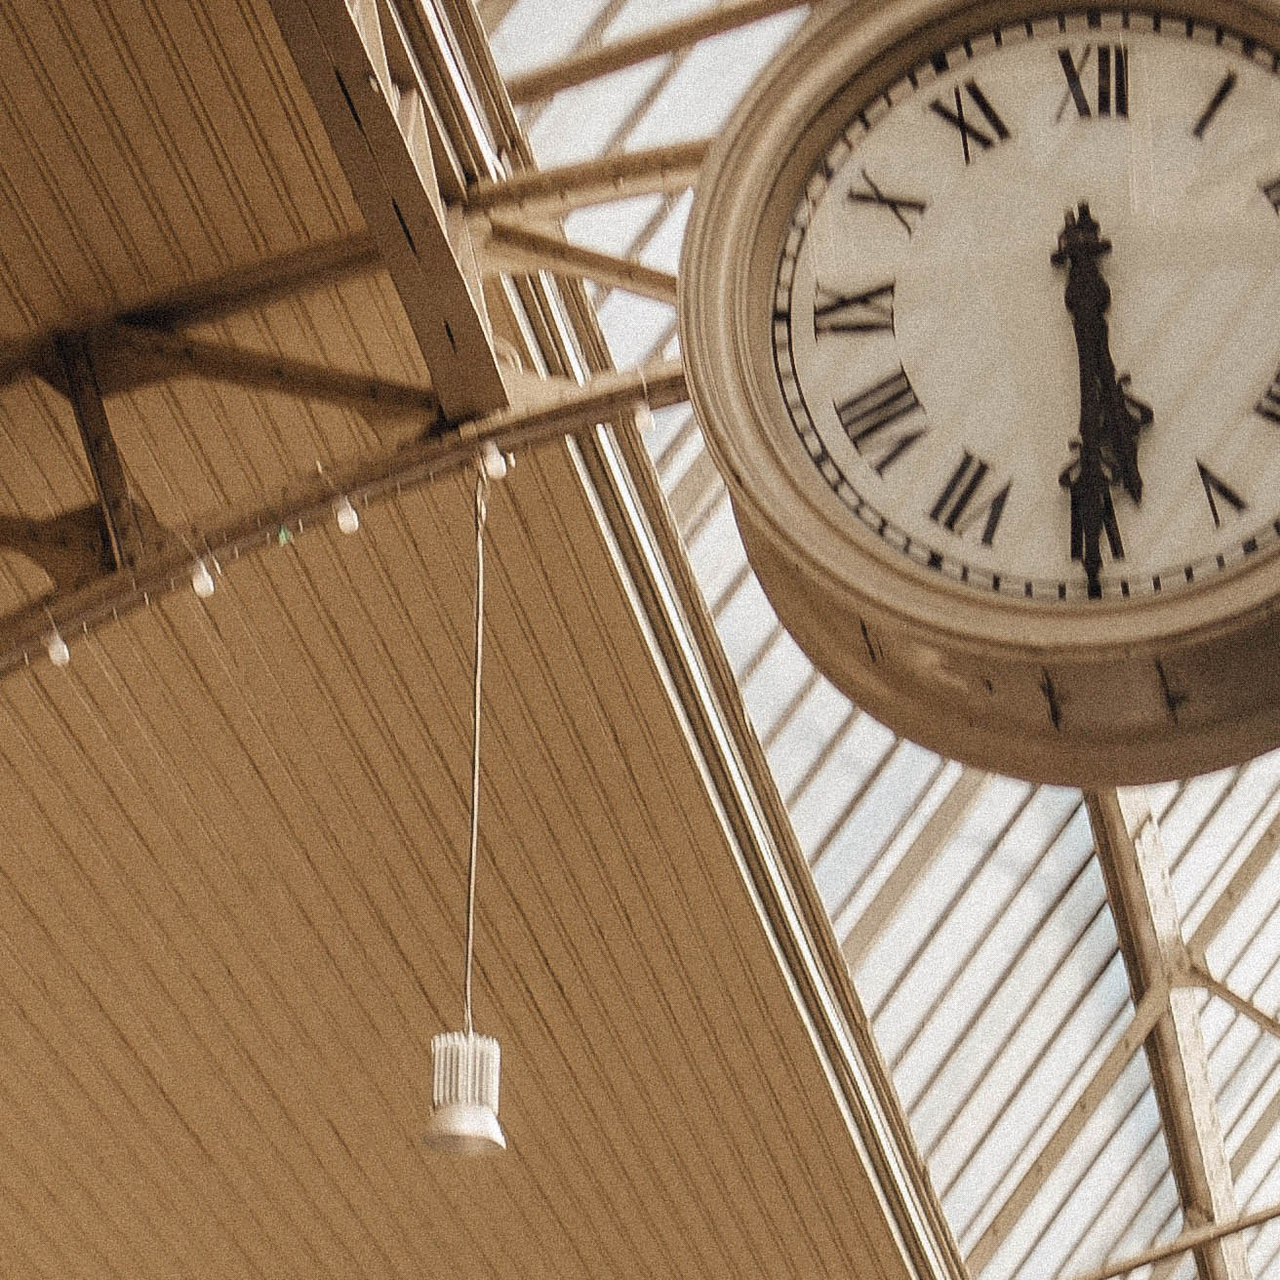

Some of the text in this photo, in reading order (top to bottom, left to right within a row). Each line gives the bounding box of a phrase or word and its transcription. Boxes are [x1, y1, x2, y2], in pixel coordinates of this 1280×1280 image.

[929, 77, 1011, 165] XI
[1055, 42, 1129, 125] XII
[1193, 69, 1238, 139] I
[846, 169, 927, 237] X
[813, 276, 897, 343] IX
[832, 360, 930, 479] VIII
[928, 447, 1013, 548] VII
[1195, 457, 1248, 529] V
